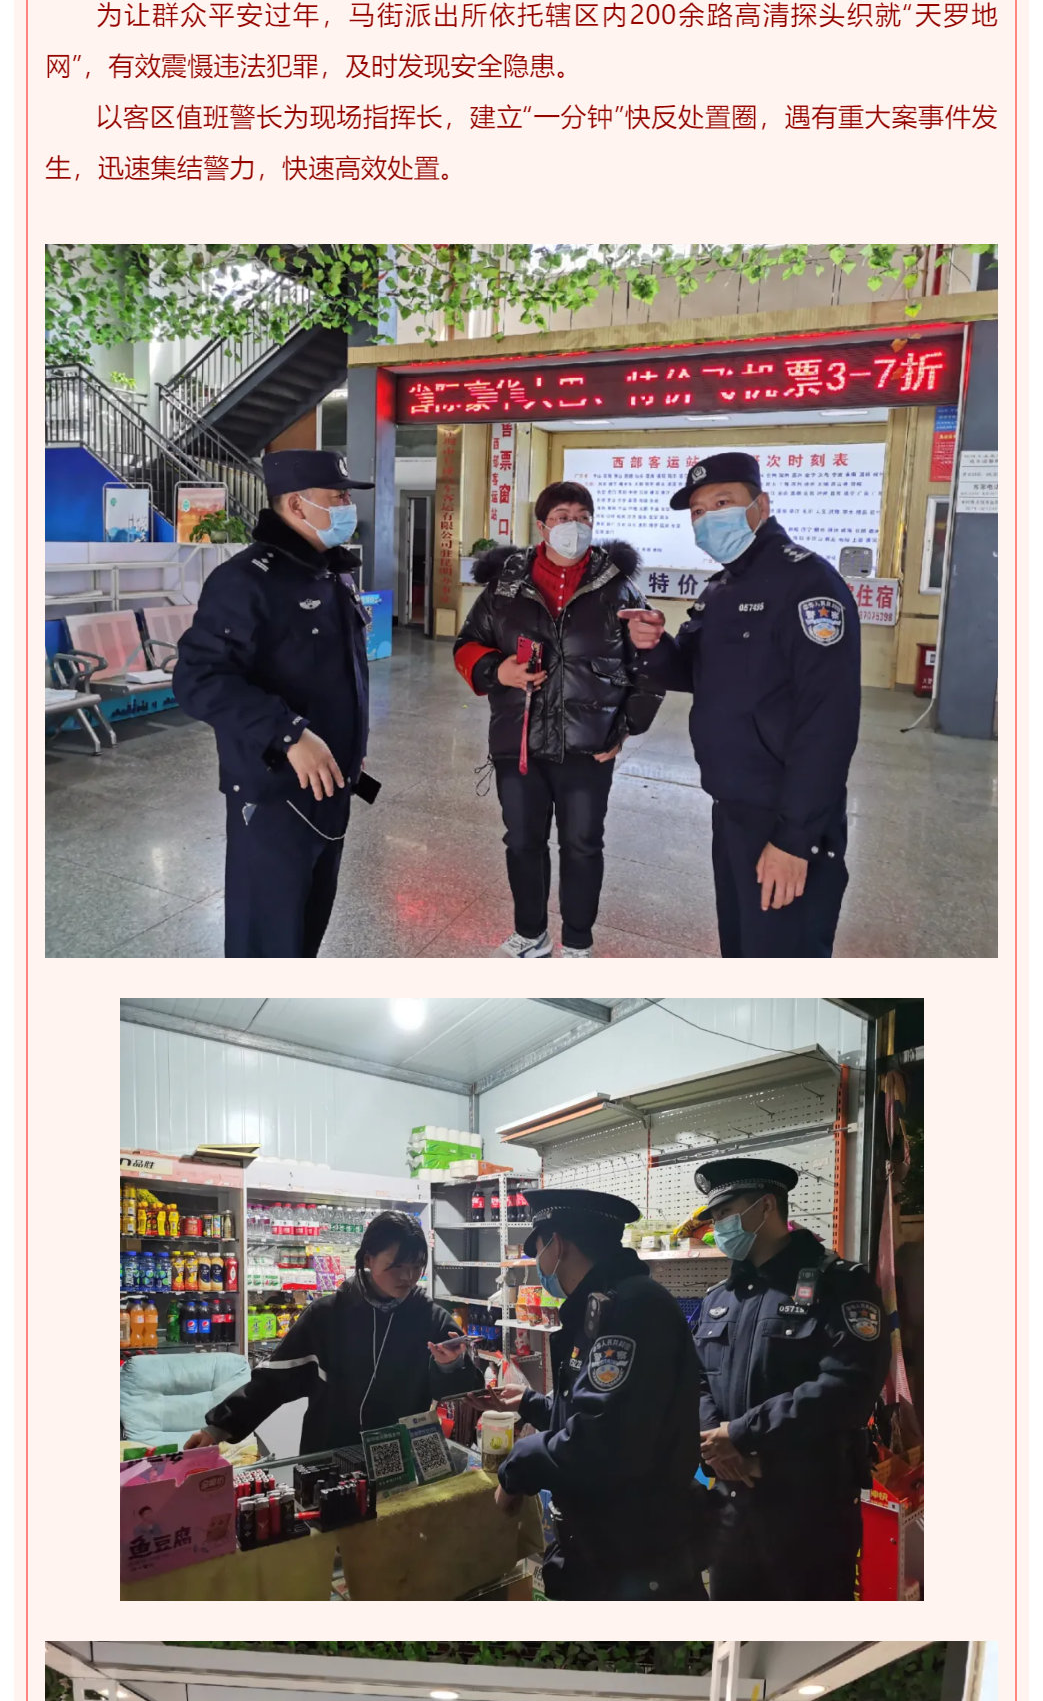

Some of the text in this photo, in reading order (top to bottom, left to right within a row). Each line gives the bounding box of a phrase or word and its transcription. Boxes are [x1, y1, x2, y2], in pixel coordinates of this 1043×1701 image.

[45, 154, 452, 182] 生，迅速集结警力，快速高效处置。
[648, 572, 699, 596] 特价
[128, 1525, 193, 1561] 鱼豆腐
